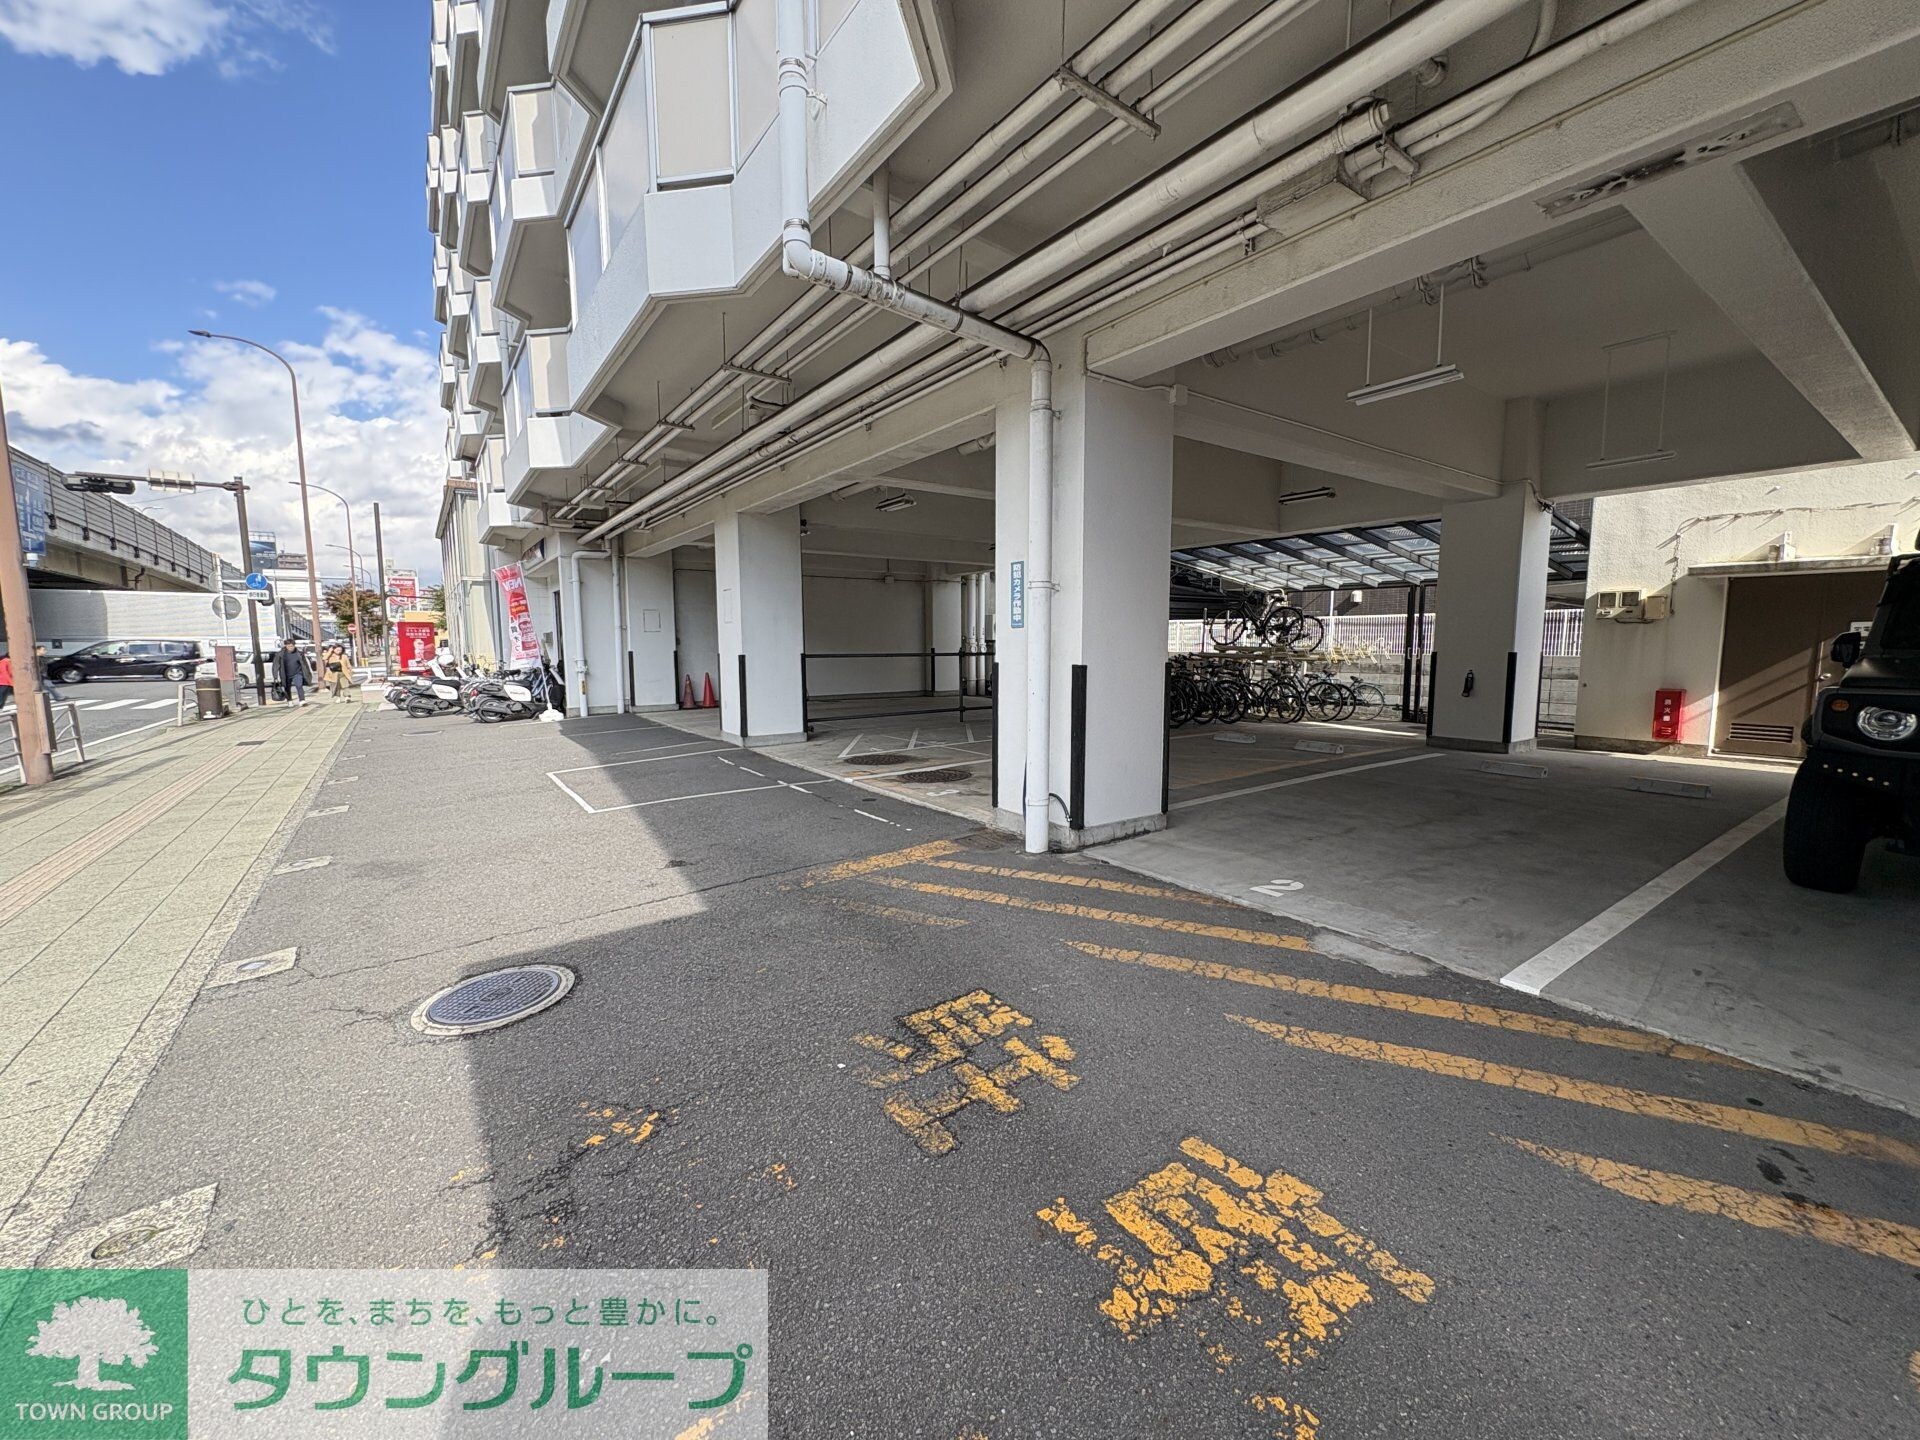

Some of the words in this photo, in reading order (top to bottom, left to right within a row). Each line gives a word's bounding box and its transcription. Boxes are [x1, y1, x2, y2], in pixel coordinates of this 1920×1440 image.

[1013, 563, 1021, 622] 防犯カメラ作動中
[1249, 879, 1305, 897] 2
